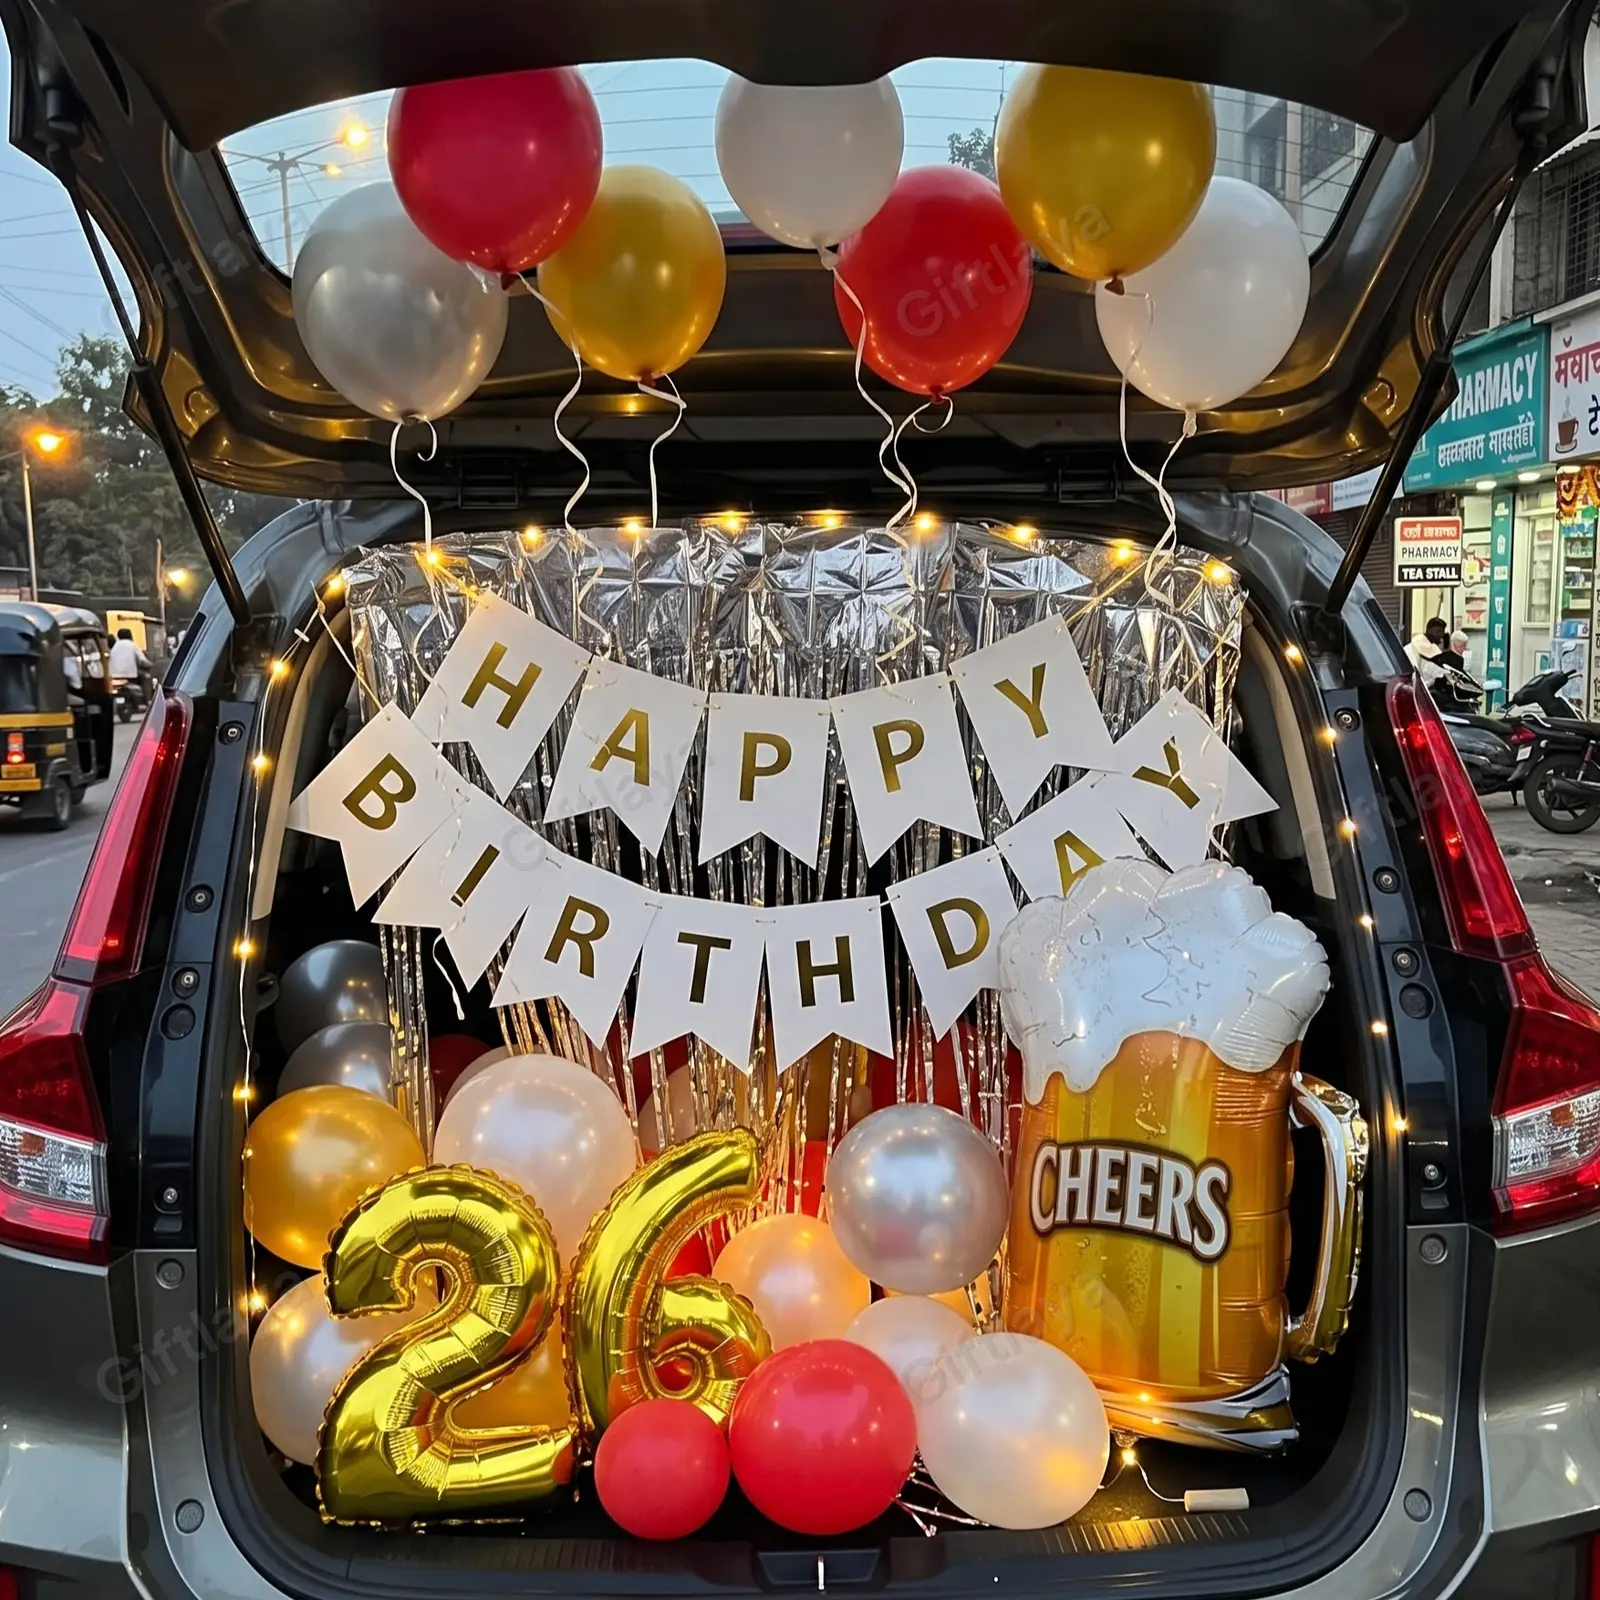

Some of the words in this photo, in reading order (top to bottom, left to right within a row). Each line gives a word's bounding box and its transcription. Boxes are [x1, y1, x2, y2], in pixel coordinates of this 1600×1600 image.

[1440, 351, 1538, 424] HARMACY
[1401, 546, 1459, 558] PHARMACY
[1402, 567, 1424, 580] TEA
[1425, 567, 1458, 580] STALL
[461, 640, 1050, 802] HAPPY
[342, 736, 1200, 1008] BIRTHDAY
[1031, 1143, 1230, 1260] CHEERS
[313, 1126, 773, 1533] 26
